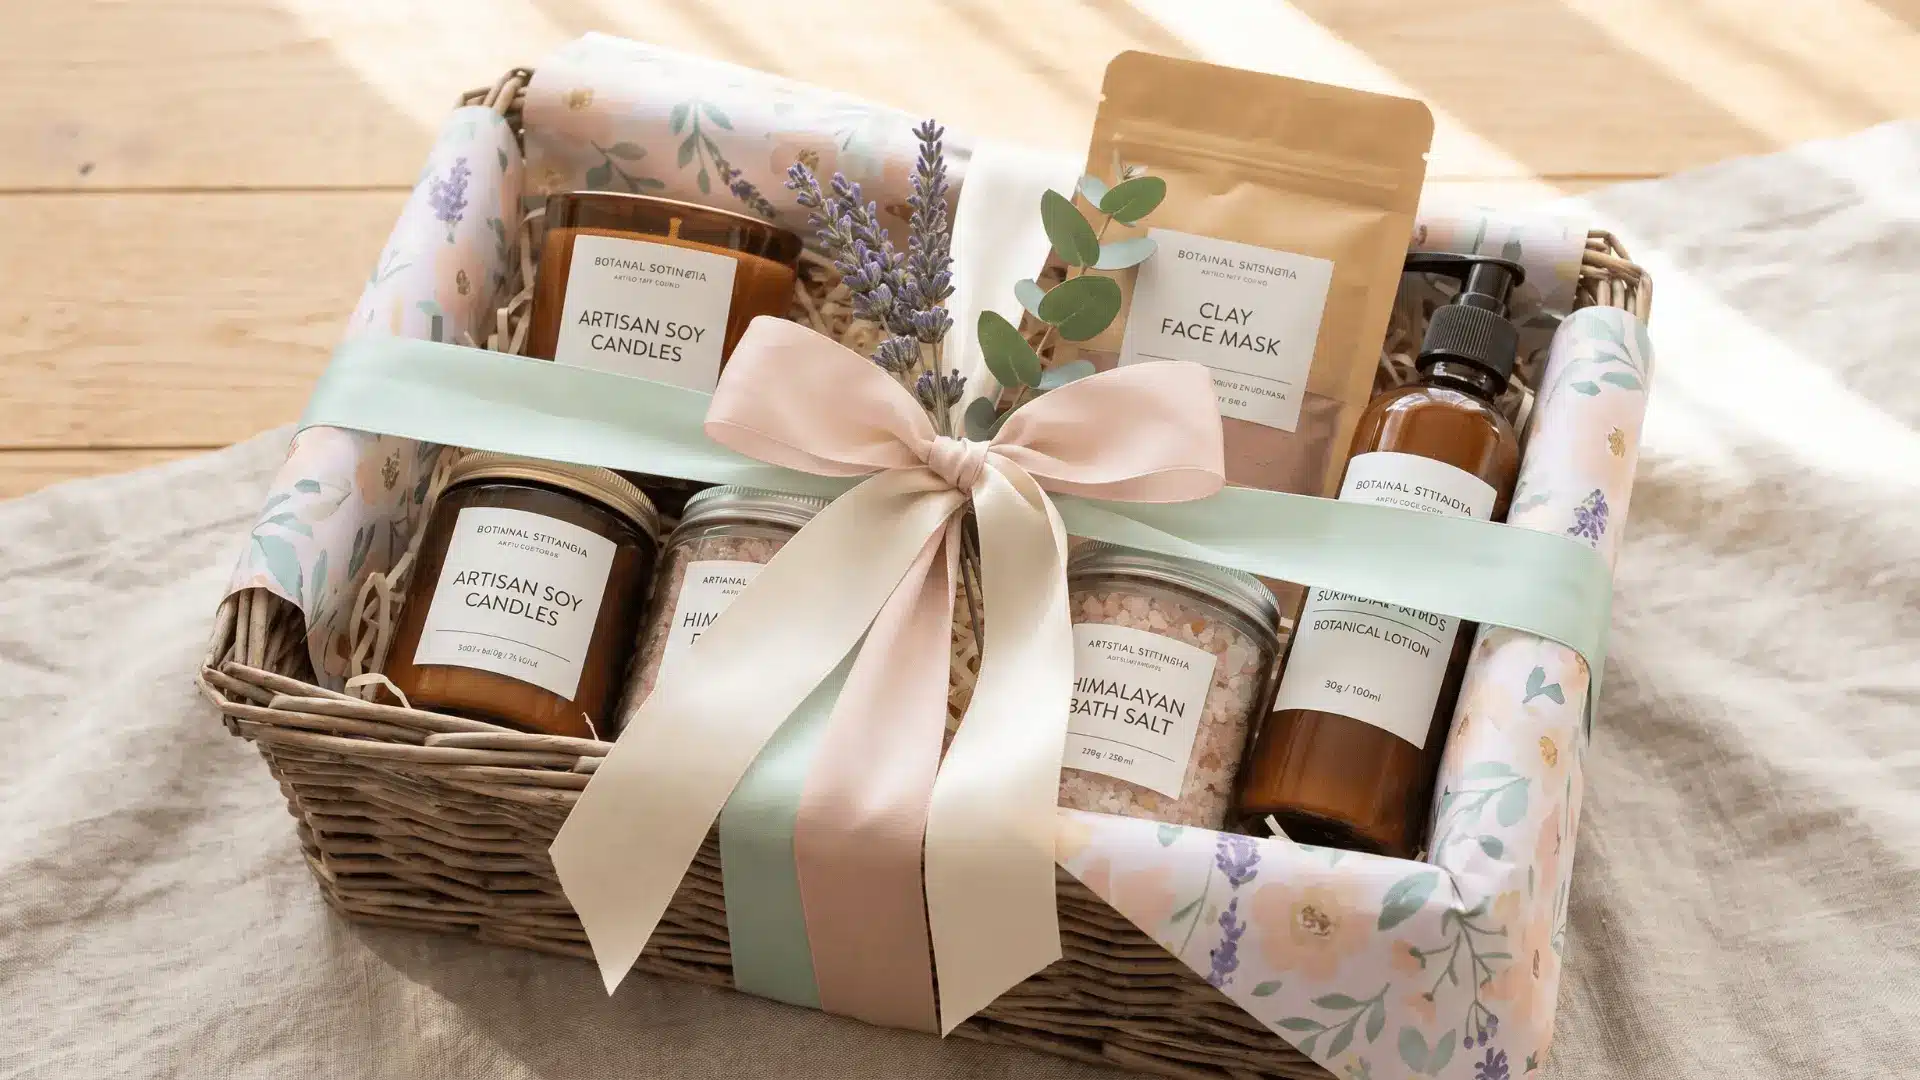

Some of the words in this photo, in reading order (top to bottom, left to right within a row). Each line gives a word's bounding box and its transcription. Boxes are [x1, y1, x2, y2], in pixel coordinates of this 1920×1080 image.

[579, 310, 660, 335] ARTISAN
[665, 322, 705, 343] SOY
[1200, 302, 1253, 326] CLAY
[591, 334, 683, 362] CANDLES
[1161, 318, 1215, 343] FACE
[1220, 330, 1281, 356] MASK
[453, 571, 538, 596] ARTISAN
[543, 586, 583, 612] SOY
[465, 593, 560, 626] CANDLES
[1313, 620, 1380, 638] BOTANICAL
[1384, 630, 1430, 657] LOTION
[1325, 680, 1342, 693] 30g
[1353, 686, 1381, 702] 100ml
[1124, 708, 1174, 736] SALT
